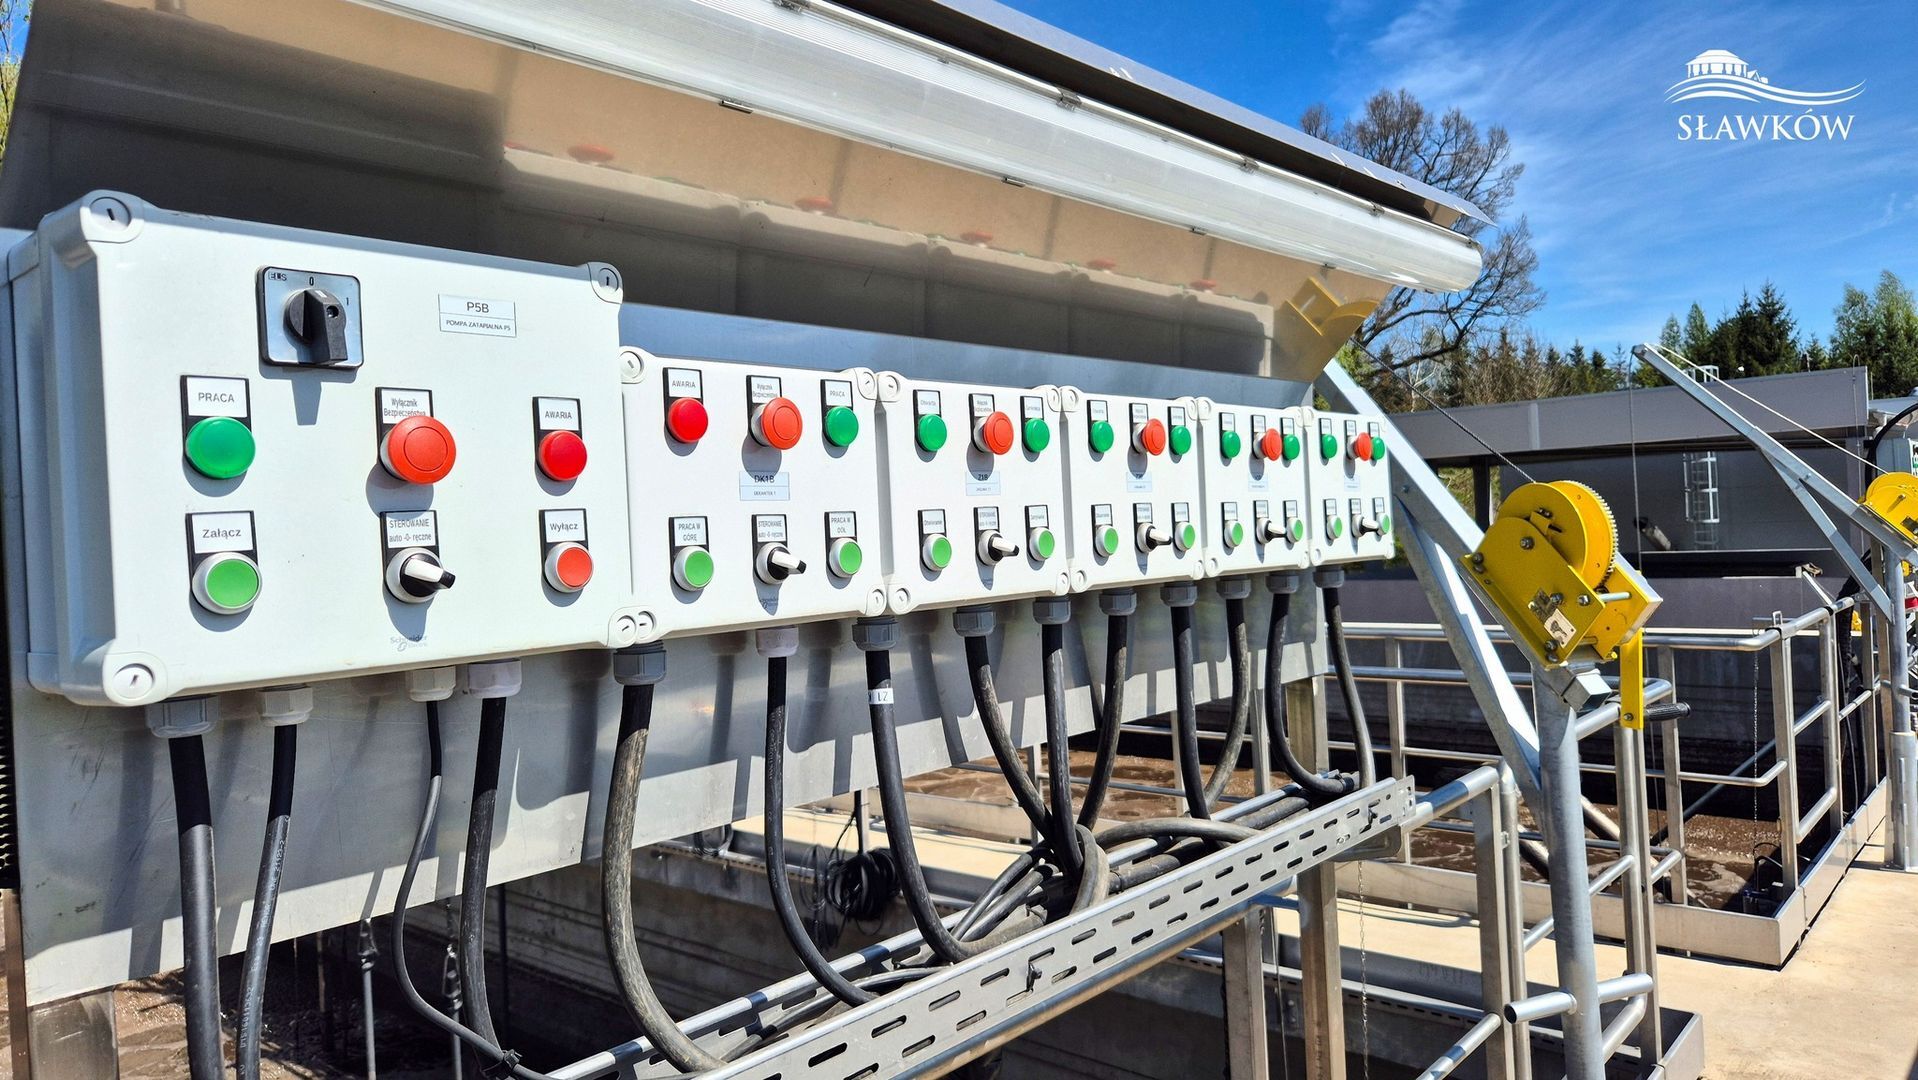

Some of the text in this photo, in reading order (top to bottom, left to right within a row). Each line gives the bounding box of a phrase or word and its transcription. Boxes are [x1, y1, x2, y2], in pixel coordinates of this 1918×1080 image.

[309, 276, 315, 286] 0
[466, 301, 490, 313] P5B
[446, 319, 468, 327] POMPA
[672, 380, 696, 388] AWARIA
[198, 392, 235, 403] PRACA
[391, 397, 418, 408] Wyłącznik
[544, 410, 572, 419] AWARIA
[389, 518, 430, 529] STEROWANIE
[549, 522, 579, 532] Wyłącz
[202, 528, 242, 540] Załącz
[389, 534, 403, 542] auto
[412, 533, 432, 542] ręczne
